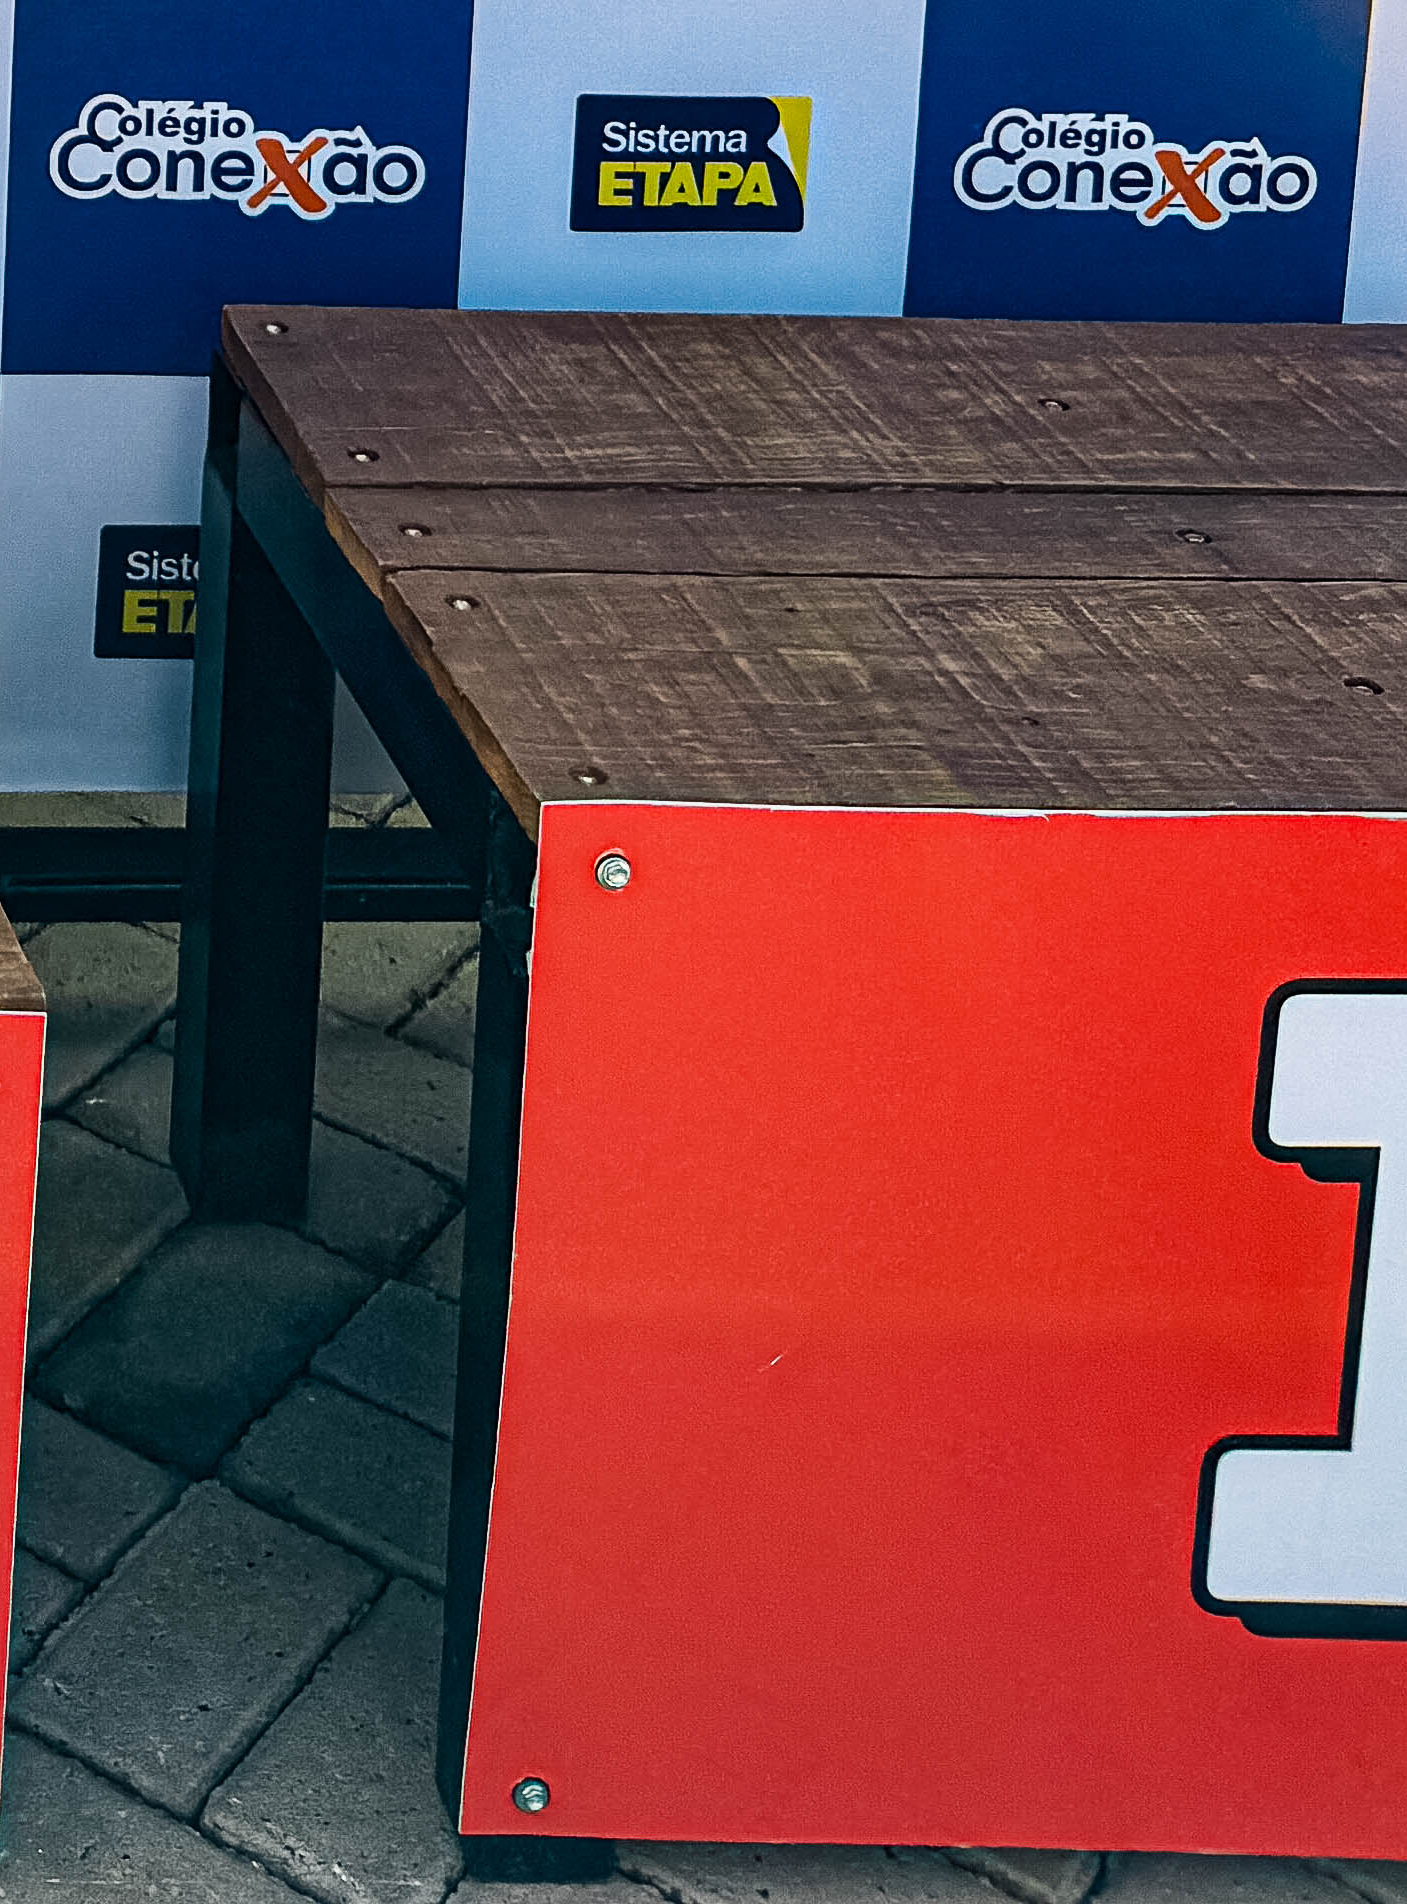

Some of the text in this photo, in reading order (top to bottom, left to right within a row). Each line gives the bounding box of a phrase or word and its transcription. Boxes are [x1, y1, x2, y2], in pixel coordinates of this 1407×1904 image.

[89, 100, 246, 143] Colégio
[603, 122, 748, 155] Sistema
[990, 113, 1145, 158] Colégio
[597, 163, 777, 209] ETAPA
